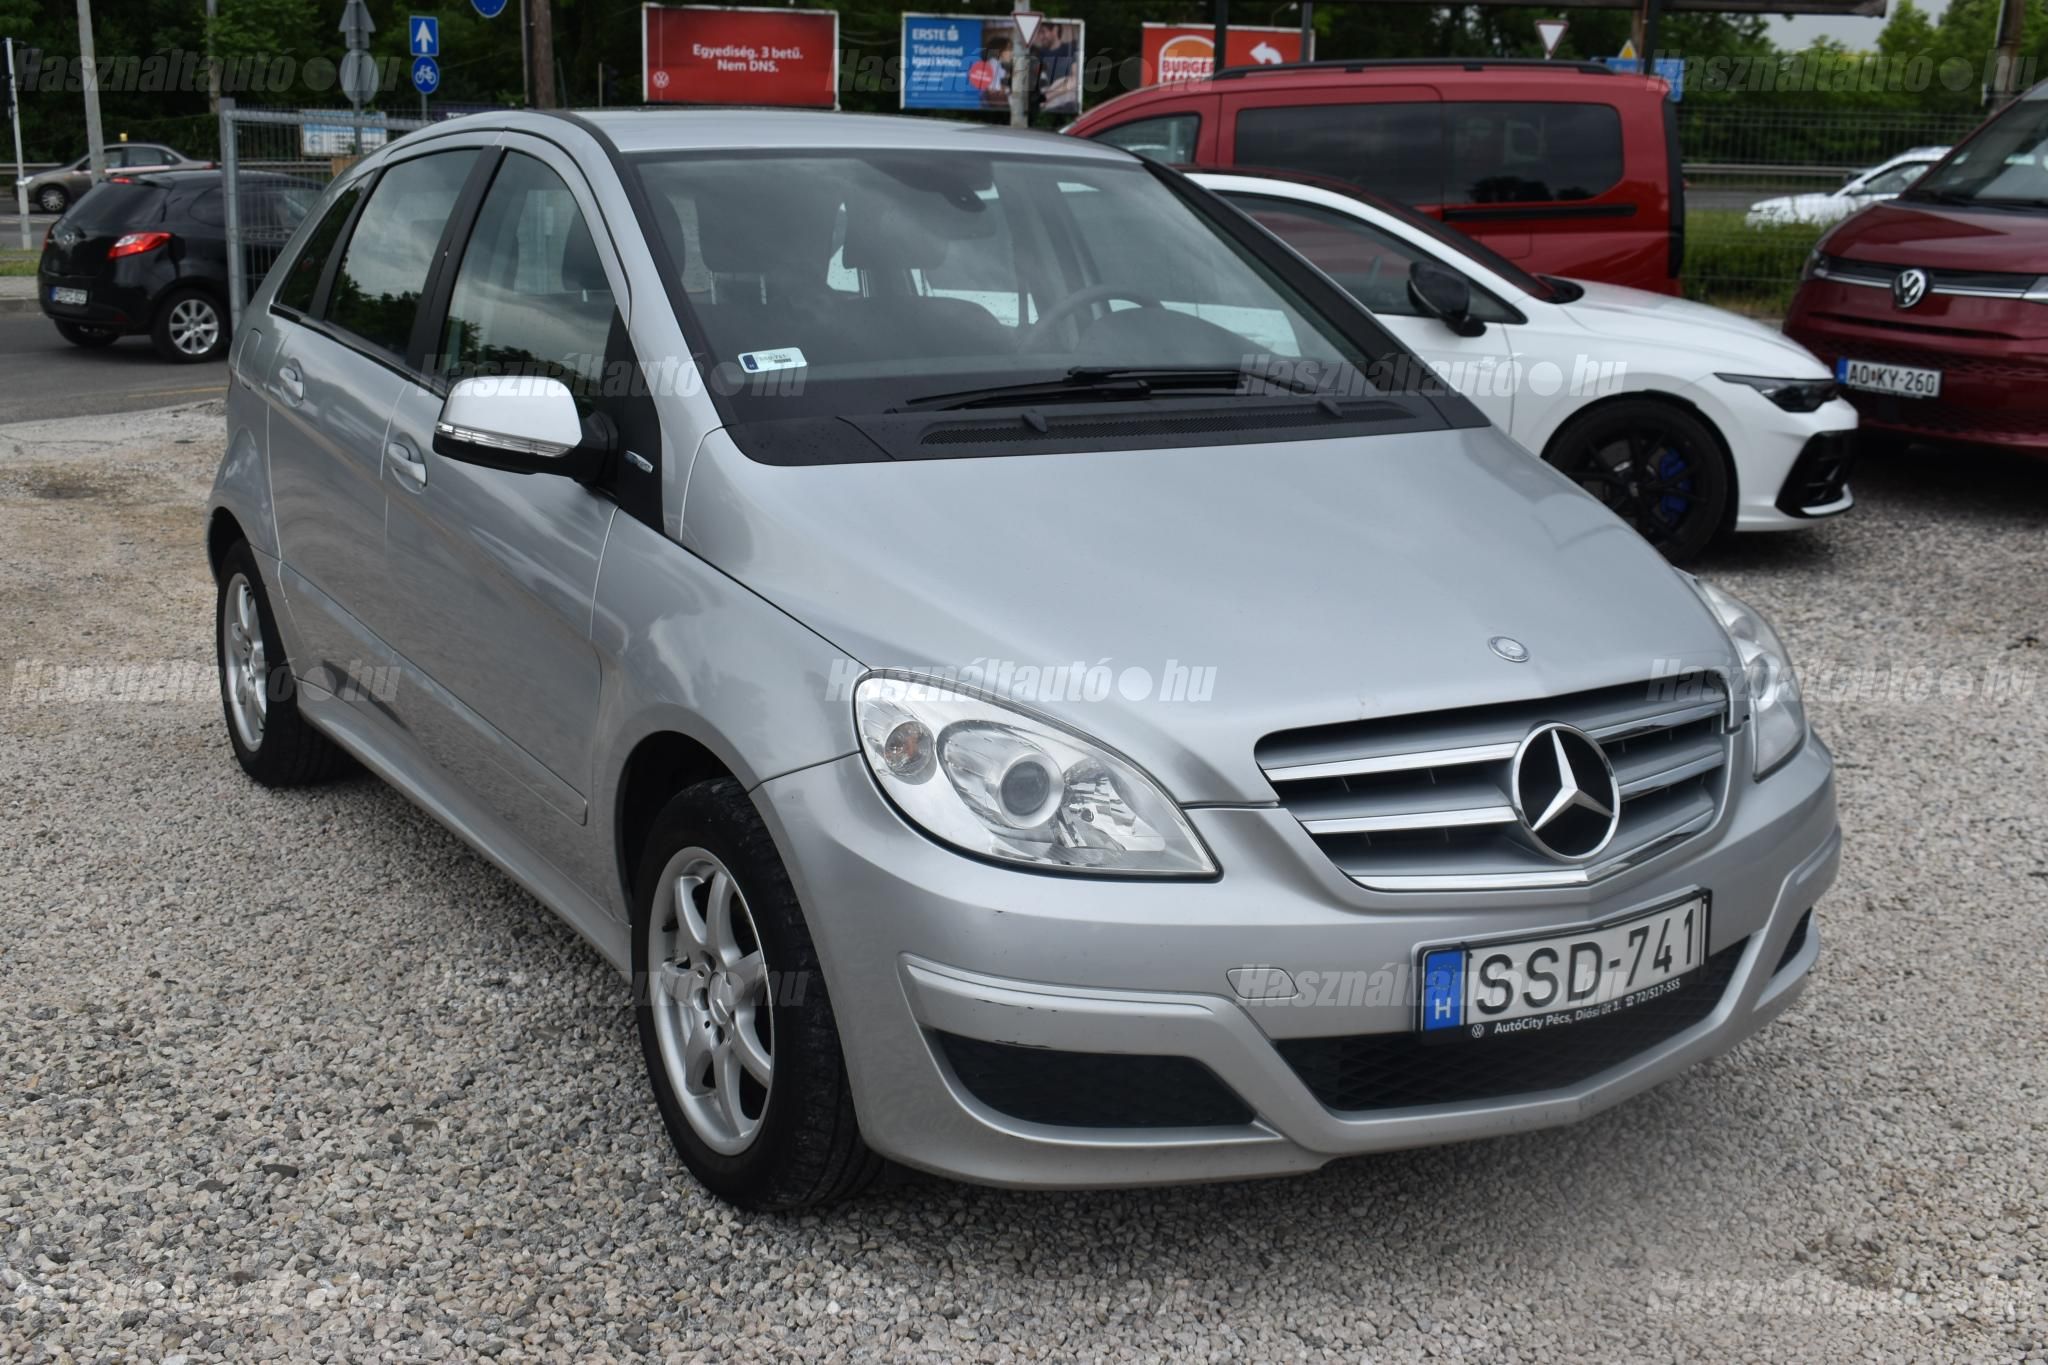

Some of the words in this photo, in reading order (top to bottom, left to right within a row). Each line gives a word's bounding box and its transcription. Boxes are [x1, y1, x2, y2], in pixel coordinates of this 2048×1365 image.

[912, 28, 946, 41] ERSTE
[693, 43, 759, 60] Egyediség.
[761, 46, 769, 58] 3
[717, 59, 747, 72] Nem
[749, 60, 779, 73] DNS.
[1476, 908, 1695, 1015] SSD-741
[1434, 997, 1451, 1020] H
[1494, 1017, 1544, 1034] AutóCity
[1575, 1006, 1601, 1021] Diósi
